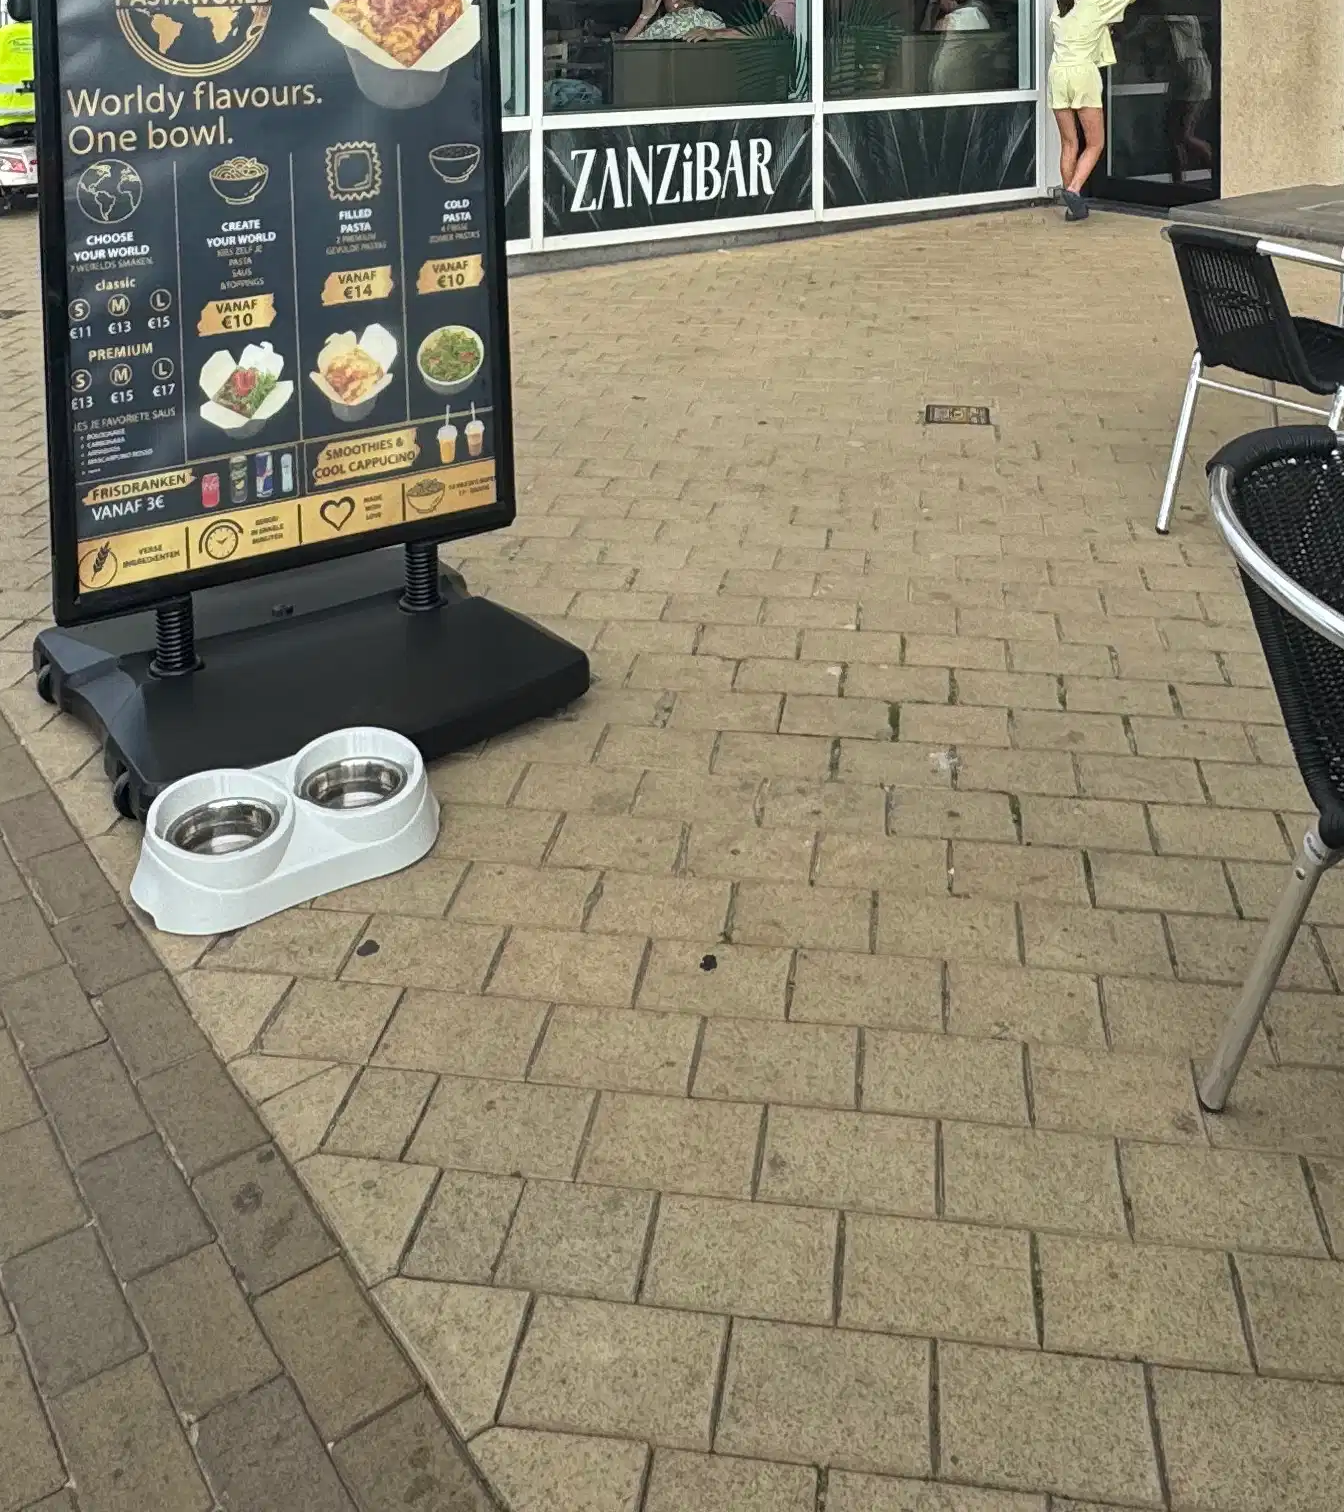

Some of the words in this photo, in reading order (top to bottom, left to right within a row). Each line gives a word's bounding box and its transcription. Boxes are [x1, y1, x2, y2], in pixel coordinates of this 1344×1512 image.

[67, 85, 184, 121] Worldy
[194, 81, 323, 113] flavours.
[68, 123, 137, 155] One
[148, 116, 233, 152] bowl.
[444, 199, 470, 210] COLD
[338, 208, 372, 220] FILLED
[443, 211, 472, 223] PASTA
[221, 219, 260, 231] CREATE
[340, 221, 372, 233] PASTA
[86, 232, 134, 246] CHOOSE
[206, 236, 238, 249] YOUR
[238, 232, 276, 245] WORLD
[73, 249, 106, 262] YOUR
[107, 245, 150, 258] WORLD
[431, 261, 469, 274] VANAF
[95, 277, 136, 291] classic
[338, 270, 377, 285] VANAF
[437, 273, 465, 289] €10
[343, 284, 372, 299] €14
[76, 303, 84, 317] S
[112, 299, 126, 312] M
[156, 293, 165, 306] L
[215, 299, 258, 314] VANAF
[69, 325, 92, 339] €11
[108, 320, 132, 335] €13
[148, 316, 170, 329] €15
[222, 313, 253, 330] €10
[88, 342, 153, 362] PREMIUM
[76, 374, 85, 387] S
[114, 368, 128, 381] M
[159, 362, 167, 376] L
[111, 389, 134, 403] €15
[153, 383, 175, 397] €17
[326, 439, 393, 461] SMOOTHIES
[315, 464, 345, 480] COOL
[348, 451, 416, 472] CAPPUCINO
[92, 473, 186, 501] FRISDRANKEN
[91, 500, 143, 521] VANAF
[147, 494, 165, 511] 3€
